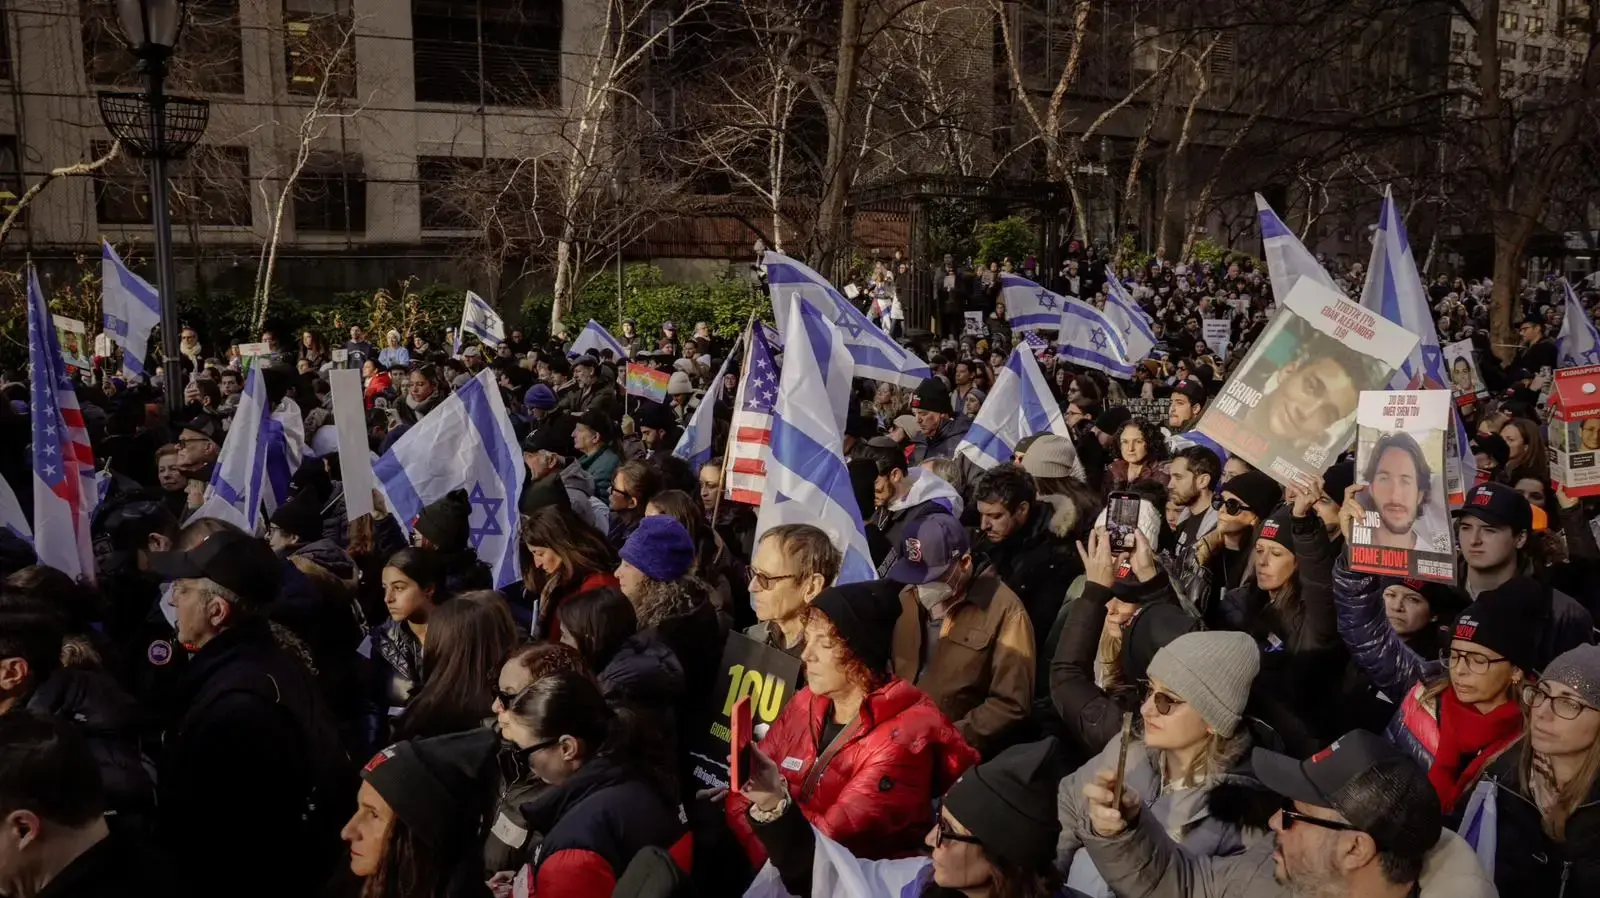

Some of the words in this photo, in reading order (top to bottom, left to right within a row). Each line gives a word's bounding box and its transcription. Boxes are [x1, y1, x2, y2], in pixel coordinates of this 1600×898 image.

[1215, 393, 1243, 418] HIM
[1226, 379, 1264, 409] BRING
[1352, 511, 1380, 528] ING
[1352, 526, 1371, 545] HIM
[1351, 546, 1379, 565] HOME
[1381, 549, 1408, 569] NOW!
